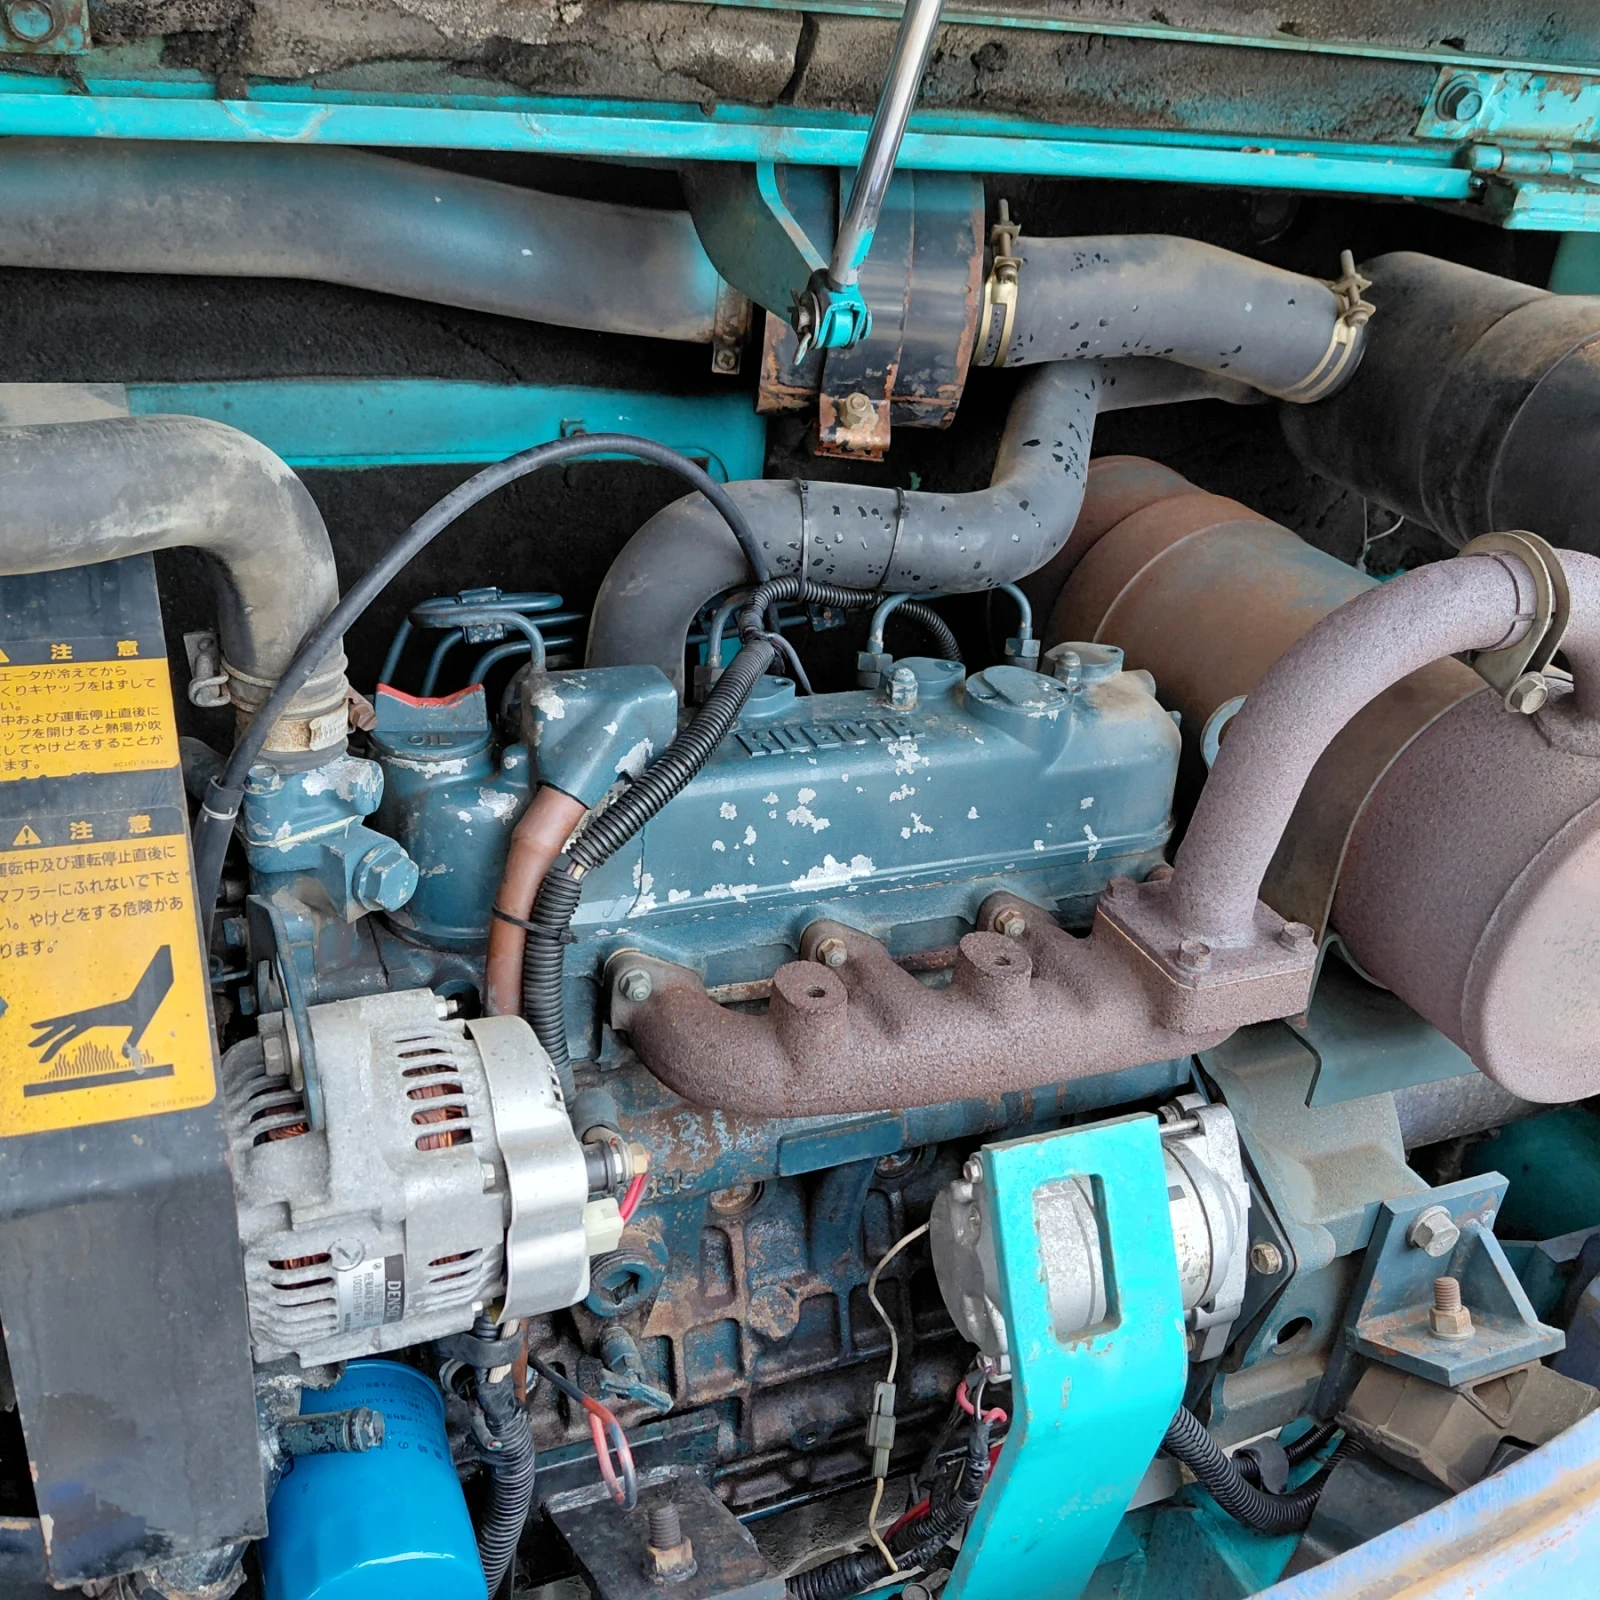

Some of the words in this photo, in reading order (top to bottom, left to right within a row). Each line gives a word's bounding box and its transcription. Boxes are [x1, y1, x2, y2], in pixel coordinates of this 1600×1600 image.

[1, 678, 156, 697] くりキャップをはずして
[0, 706, 159, 726] 中および運転停止直後に
[0, 736, 164, 756] してやけどをすることが
[0, 759, 41, 771] ます。
[0, 870, 181, 902] マフラーにふれないで下さ
[386, 1280, 402, 1318] DENSO
